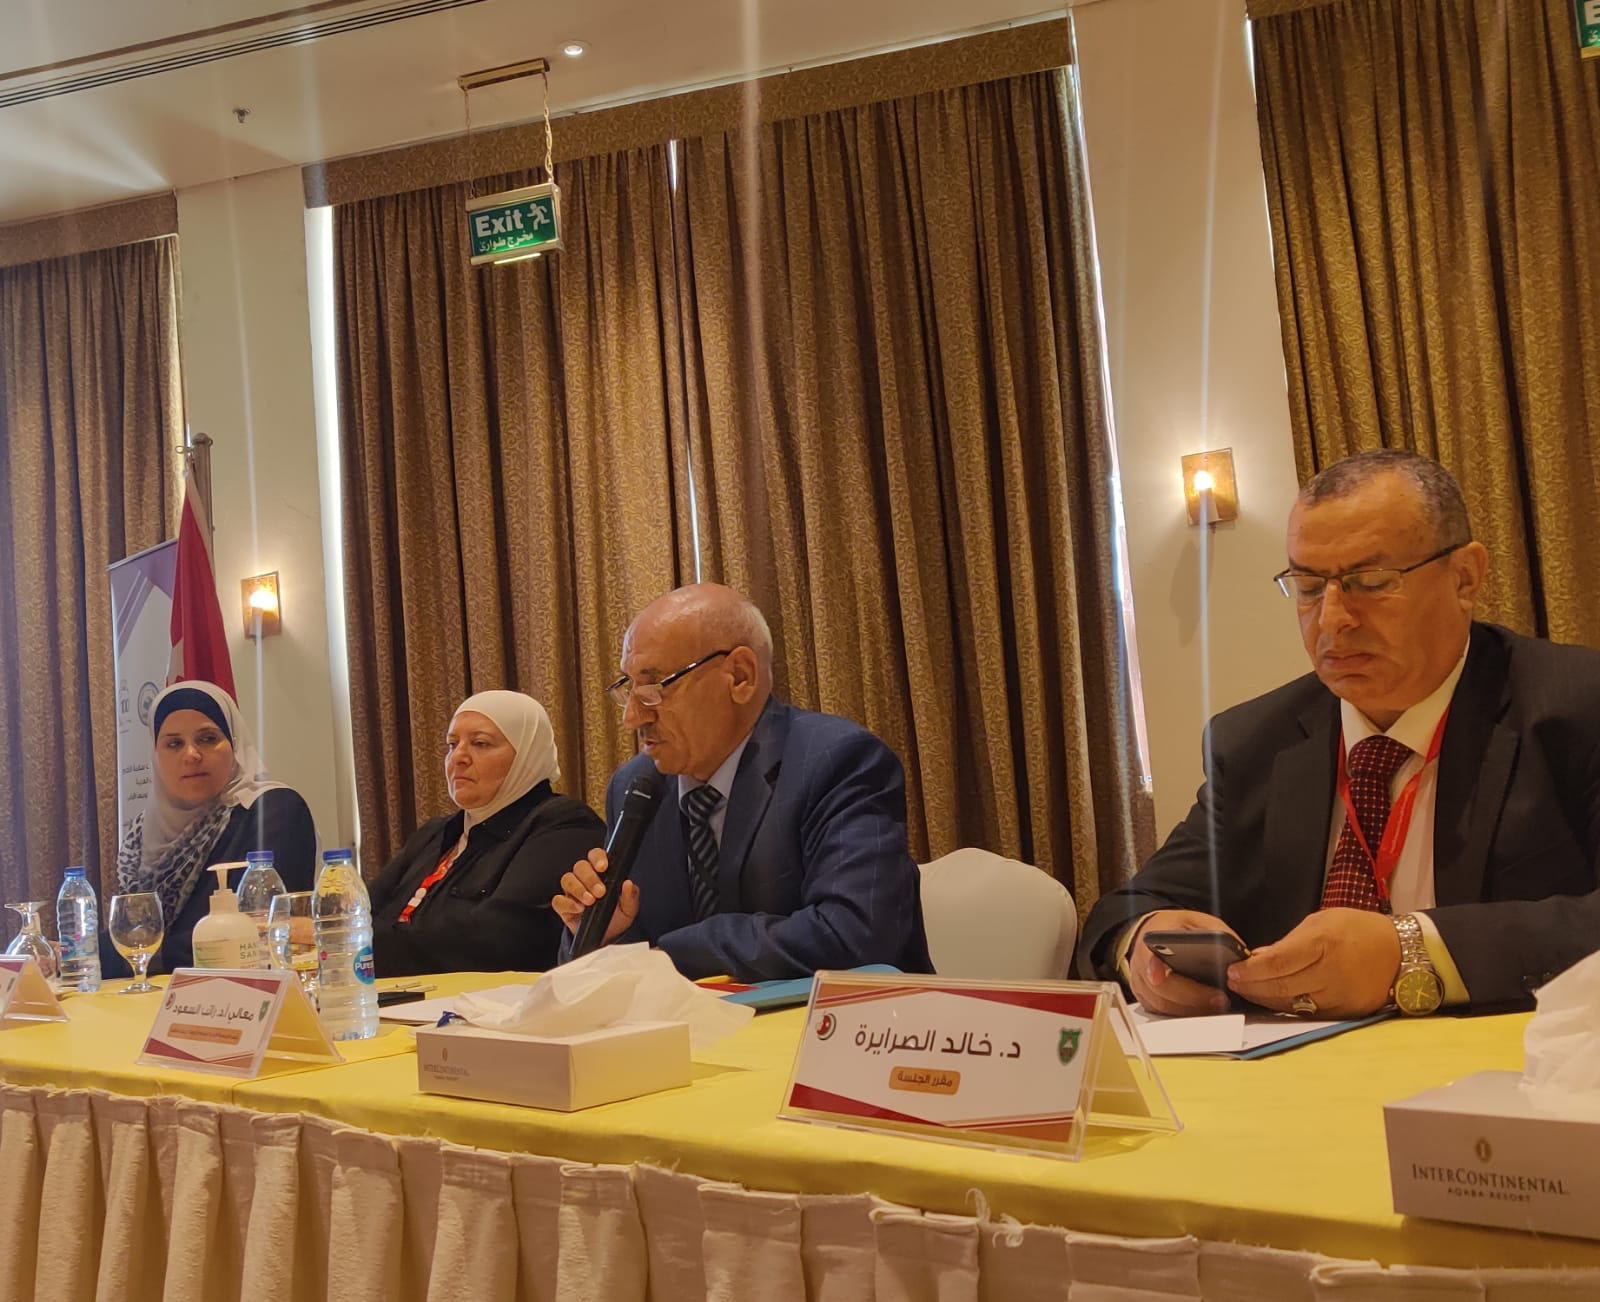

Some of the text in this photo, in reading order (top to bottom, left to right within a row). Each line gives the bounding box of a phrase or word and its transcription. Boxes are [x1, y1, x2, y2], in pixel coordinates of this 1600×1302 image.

[475, 208, 524, 238] Exit
[507, 230, 534, 248] مخرج
[854, 1023, 937, 1056] الصرايرة
[940, 1031, 993, 1057] خالد
[896, 1069, 953, 1088] مقرر الجلسة
